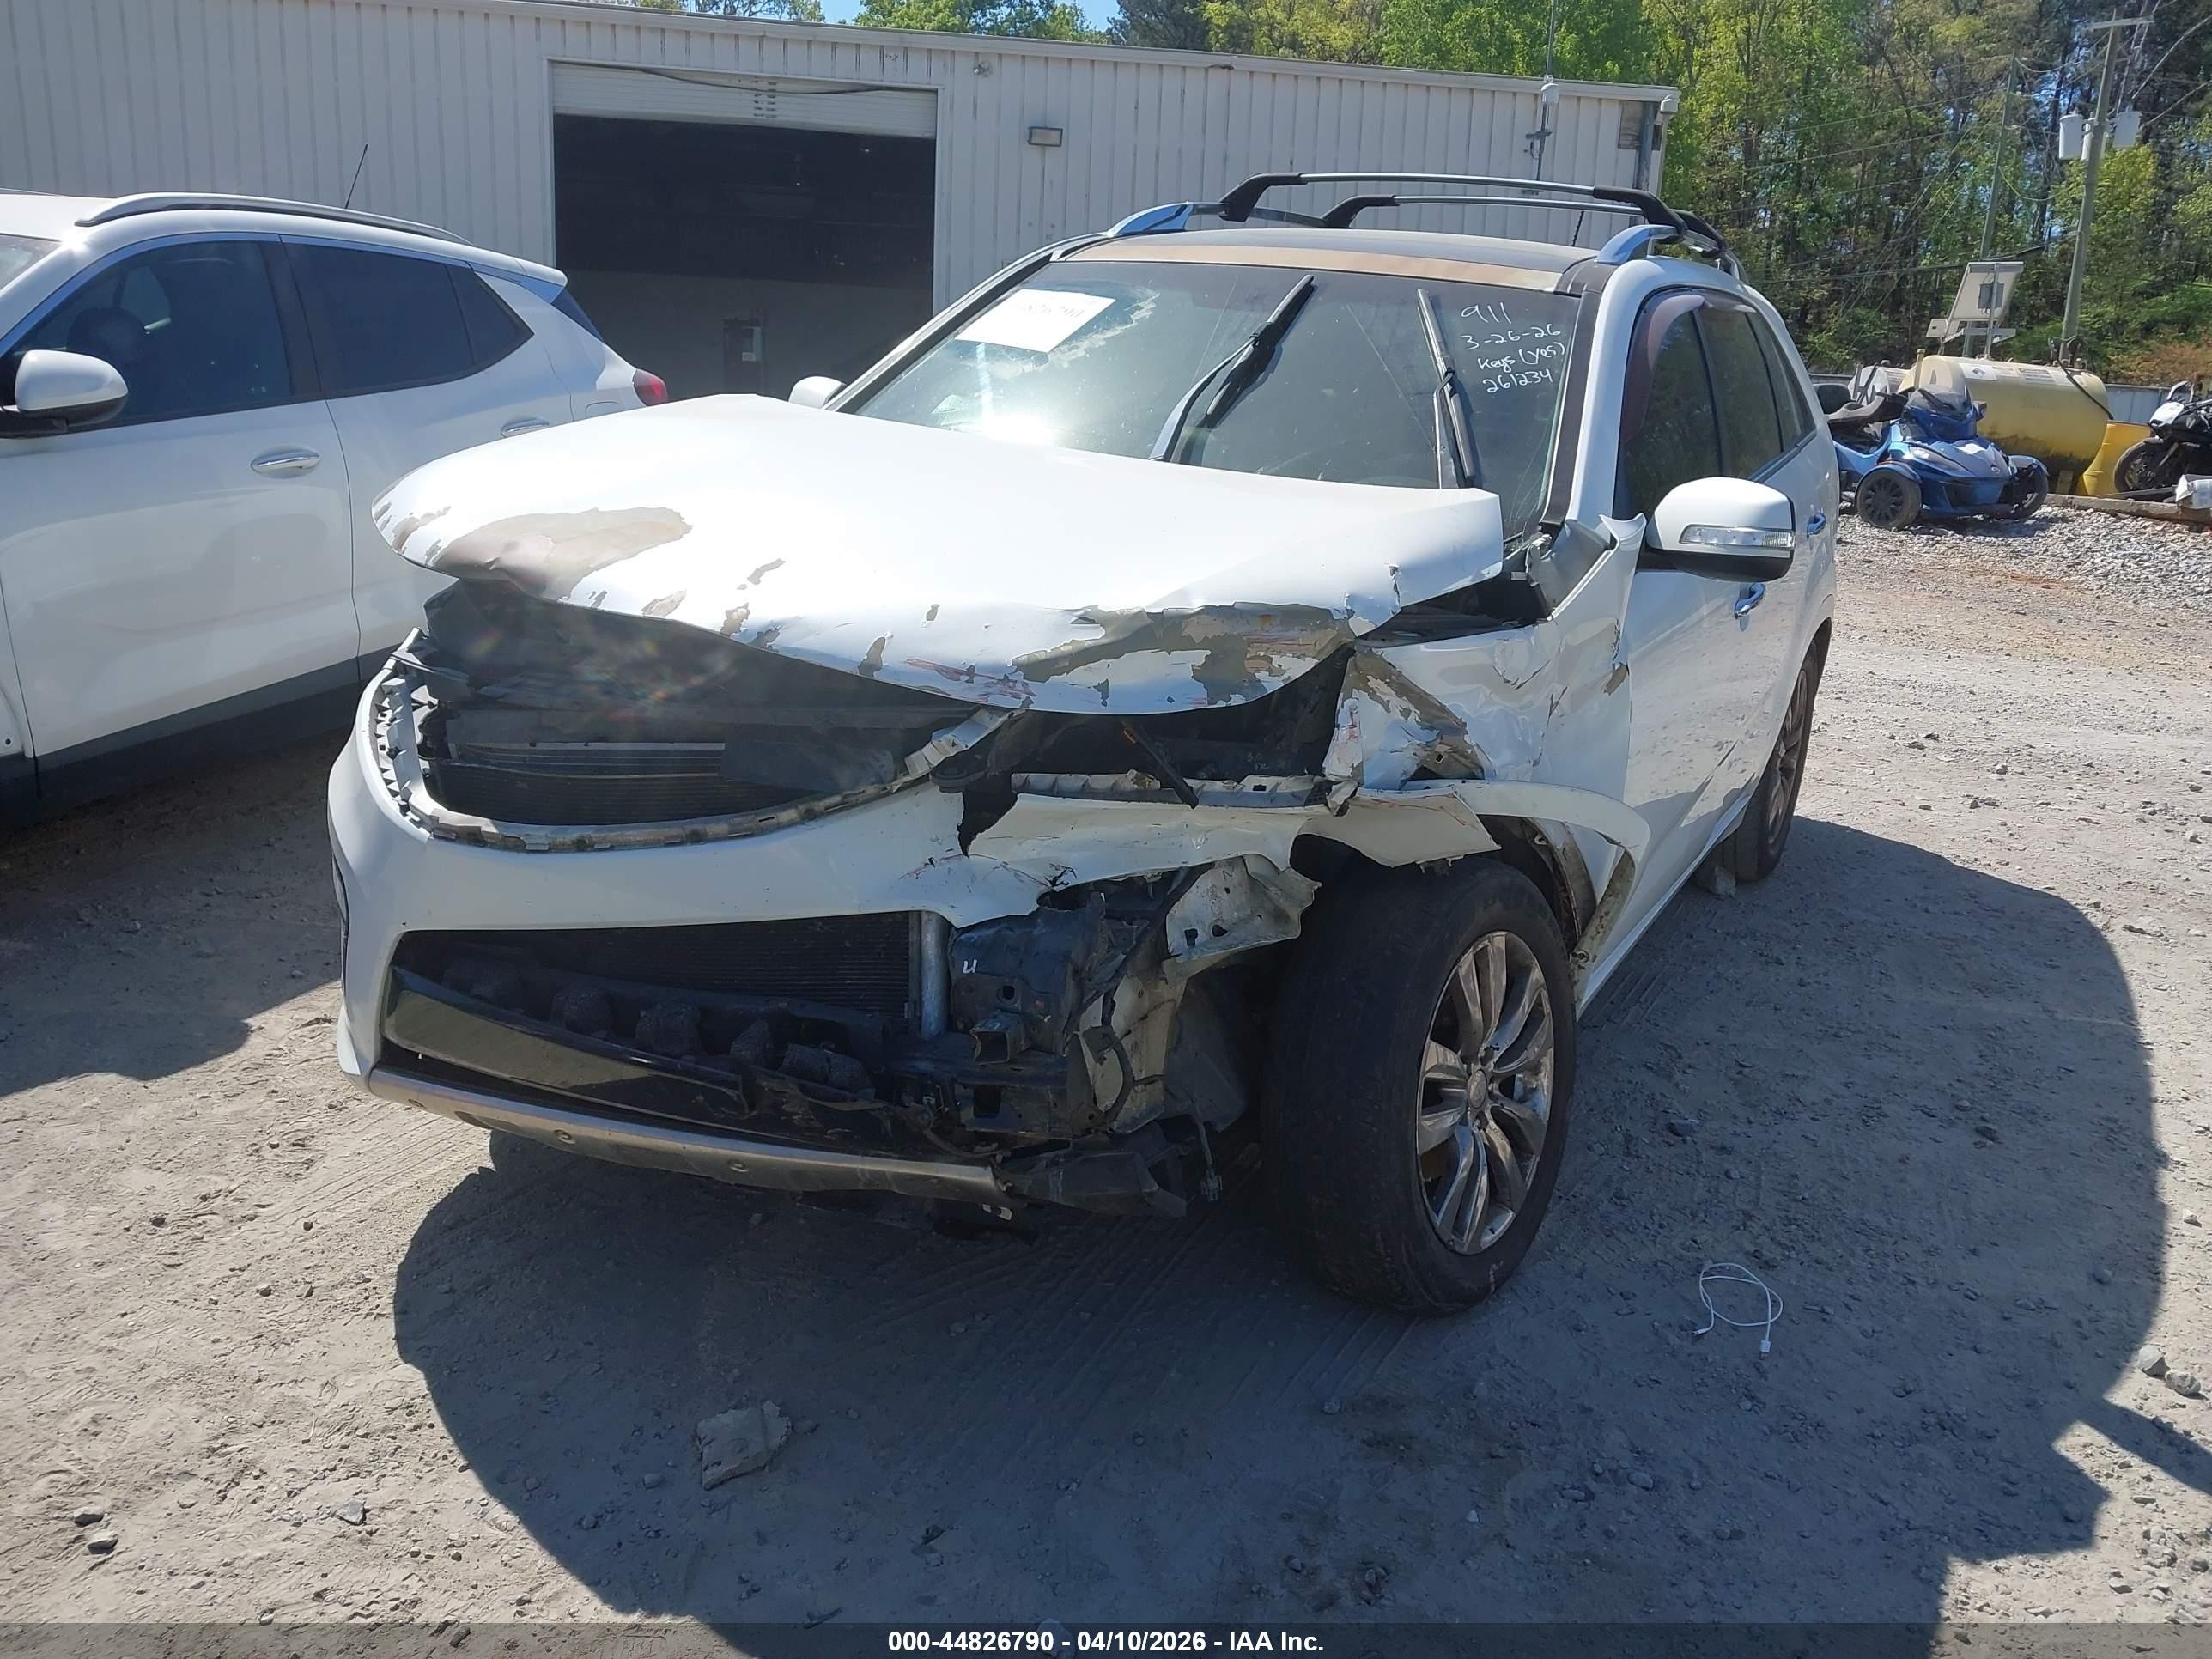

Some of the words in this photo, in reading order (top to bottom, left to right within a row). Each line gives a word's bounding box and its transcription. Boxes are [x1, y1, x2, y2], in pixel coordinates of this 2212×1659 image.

[1462, 302, 1511, 323] 911
[1460, 324, 1561, 350] 3-26-26
[1482, 368, 1553, 392] 261234
